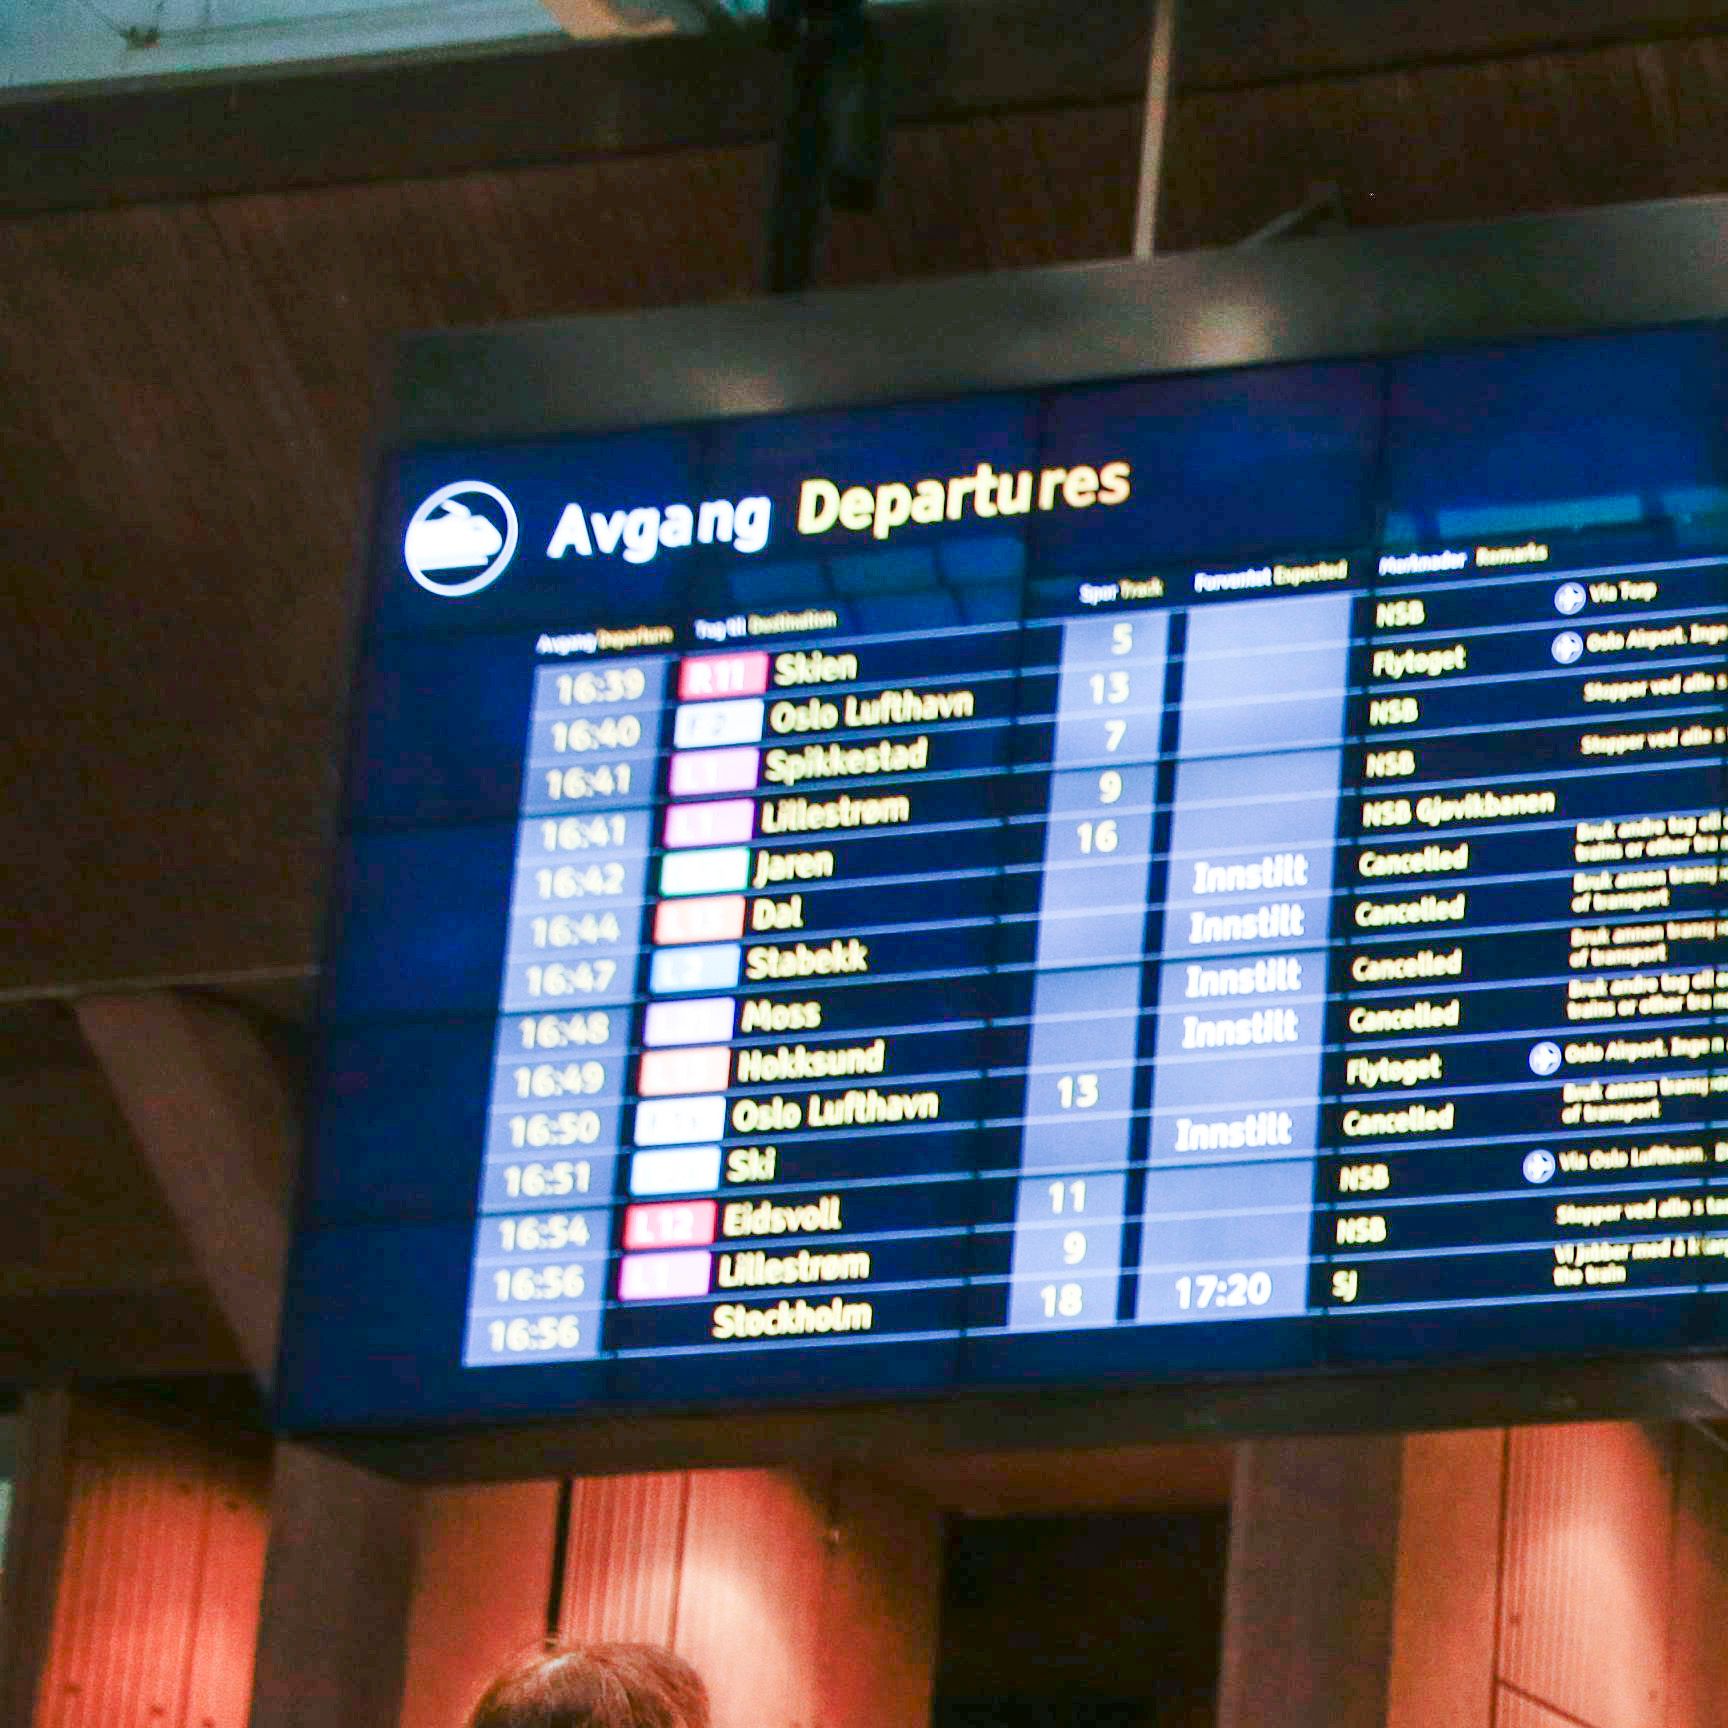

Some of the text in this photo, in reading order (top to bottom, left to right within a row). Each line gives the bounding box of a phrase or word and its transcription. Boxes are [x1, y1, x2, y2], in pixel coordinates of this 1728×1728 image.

[546, 461, 1131, 564] Avgang Departures
[1111, 623, 1133, 655] 5
[556, 668, 645, 705] 16:39
[773, 650, 858, 686] Skien
[1089, 671, 1130, 705] 13
[769, 688, 974, 734] Oslo Lufthavn
[551, 715, 641, 752] 16:40
[1104, 719, 1127, 752] 7
[764, 735, 929, 786] Spikkestad
[545, 762, 631, 800] 16:41
[1098, 771, 1122, 804] 9
[760, 794, 910, 834] Lillestrøm
[539, 814, 628, 853] 16:41
[1076, 819, 1118, 854] 16
[536, 862, 625, 899] 16:42
[752, 850, 834, 889] Jaren
[1192, 853, 1309, 894] Innstilt
[531, 912, 620, 948] 16:44
[751, 894, 804, 931] Dal
[1188, 903, 1305, 944] Innstilt
[525, 959, 617, 997] 16:47
[745, 938, 868, 980] Stabekk
[1184, 956, 1304, 1000] Innstilt
[519, 1012, 610, 1050] 16:48
[740, 998, 821, 1033] Moss
[1181, 1008, 1299, 1049] Innstilt
[514, 1061, 605, 1098] 16:49
[737, 1038, 886, 1083] Hokksund
[1056, 1073, 1099, 1109] 13
[509, 1110, 601, 1148] 16:50
[731, 1088, 939, 1133] Oslo Lufthavn
[1174, 1110, 1293, 1152] Innstilt
[503, 1160, 591, 1197] 16:51
[726, 1146, 777, 1183] Ski
[722, 1194, 842, 1237] Eidsvoll
[1048, 1180, 1086, 1214] 11
[498, 1215, 590, 1252] 16:54
[1063, 1231, 1087, 1265] 9
[494, 1264, 585, 1302] 16:56
[717, 1249, 871, 1288] Lillestrøm
[1040, 1283, 1083, 1318] 18
[1175, 1271, 1272, 1310] 17:20
[489, 1315, 580, 1352] 16:56
[711, 1297, 873, 1339] Stockholm
